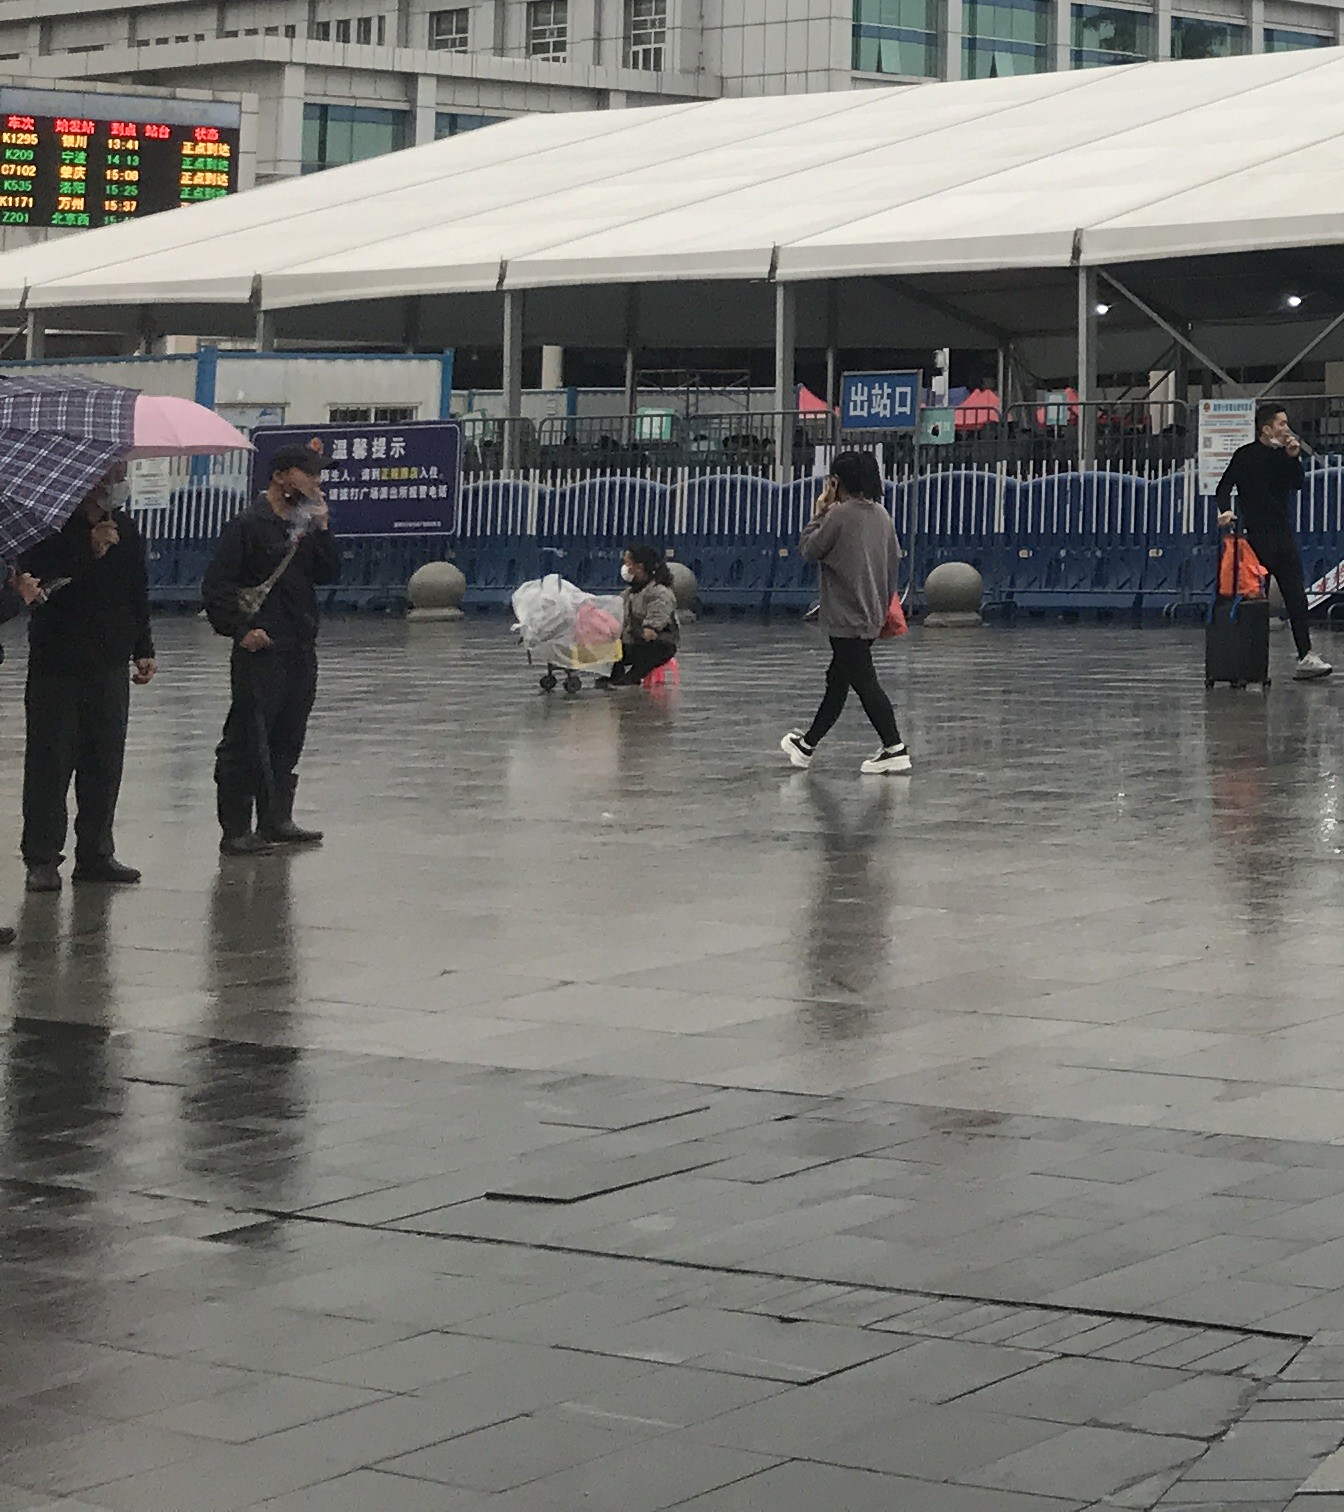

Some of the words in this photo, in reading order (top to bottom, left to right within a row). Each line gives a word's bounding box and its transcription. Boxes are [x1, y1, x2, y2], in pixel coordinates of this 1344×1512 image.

[7, 115, 35, 131] 车次
[54, 117, 95, 134] 始发站
[110, 122, 137, 137] 到点
[144, 125, 171, 139] 站台
[194, 127, 219, 140] 状态
[61, 135, 88, 148] 银川
[107, 138, 140, 151] 13:41
[181, 141, 231, 157] 正点到达
[5, 148, 34, 161] K209
[61, 151, 87, 164] 宁波
[181, 157, 230, 172] 正点到达
[4, 180, 32, 192] K535
[180, 172, 229, 187] 正点到达
[0, 196, 33, 208] K1171
[58, 197, 85, 211] 万州
[104, 200, 137, 212] 15:37
[2, 211, 29, 224] Z201
[51, 213, 90, 226] 北京西
[849, 382, 912, 418] 出站口
[332, 437, 407, 460] 温馨提示
